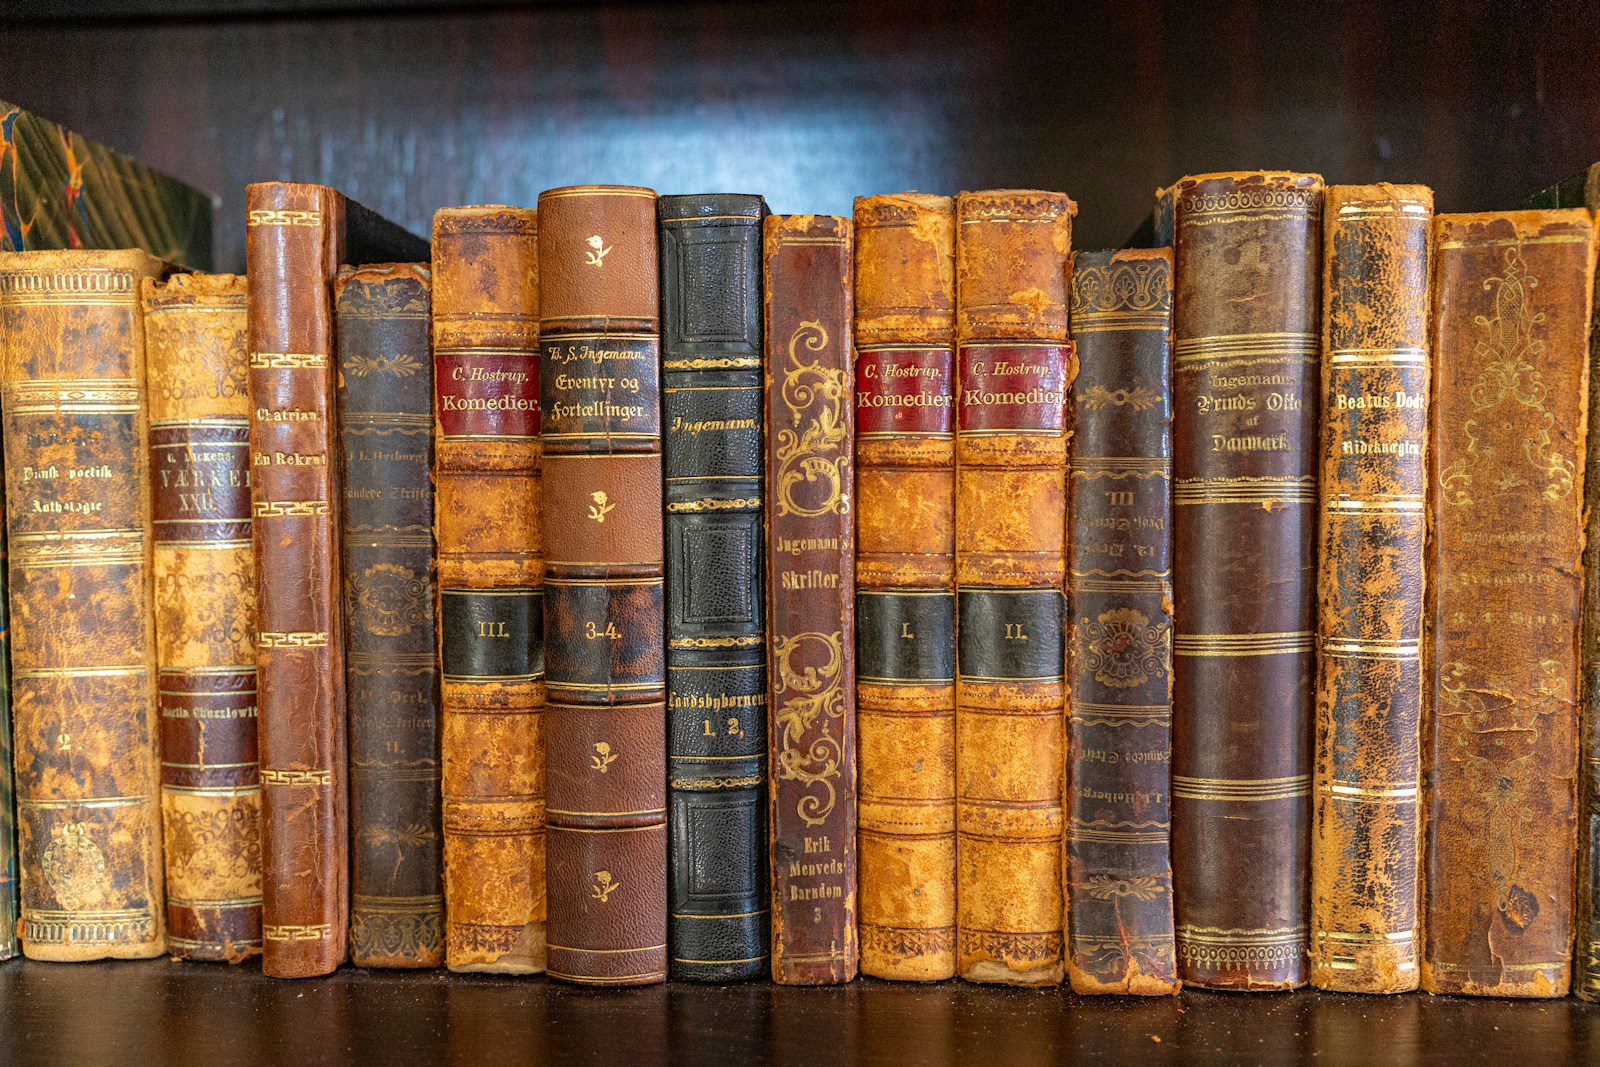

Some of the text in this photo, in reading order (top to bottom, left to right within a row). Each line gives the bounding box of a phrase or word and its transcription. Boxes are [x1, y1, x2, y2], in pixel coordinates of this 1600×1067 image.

[562, 346, 578, 364] S.
[580, 346, 646, 364] Ingemann.
[452, 367, 529, 384] C. Hostrup.
[865, 364, 942, 380] C. Hostrup.
[972, 362, 1052, 378] C. Hostrup.
[555, 375, 640, 393] Eventyr og
[442, 395, 541, 411] Komedier.
[964, 388, 1066, 406] Komedier.
[1197, 392, 1302, 416] Prinds Otto
[1336, 394, 1391, 410] Beatus
[551, 401, 649, 421] Fortællinger.
[478, 621, 510, 637] III.
[585, 621, 622, 640] 3-4.
[1005, 624, 1028, 640] II.
[804, 836, 831, 853] Erik
[790, 882, 842, 901] Barndom
